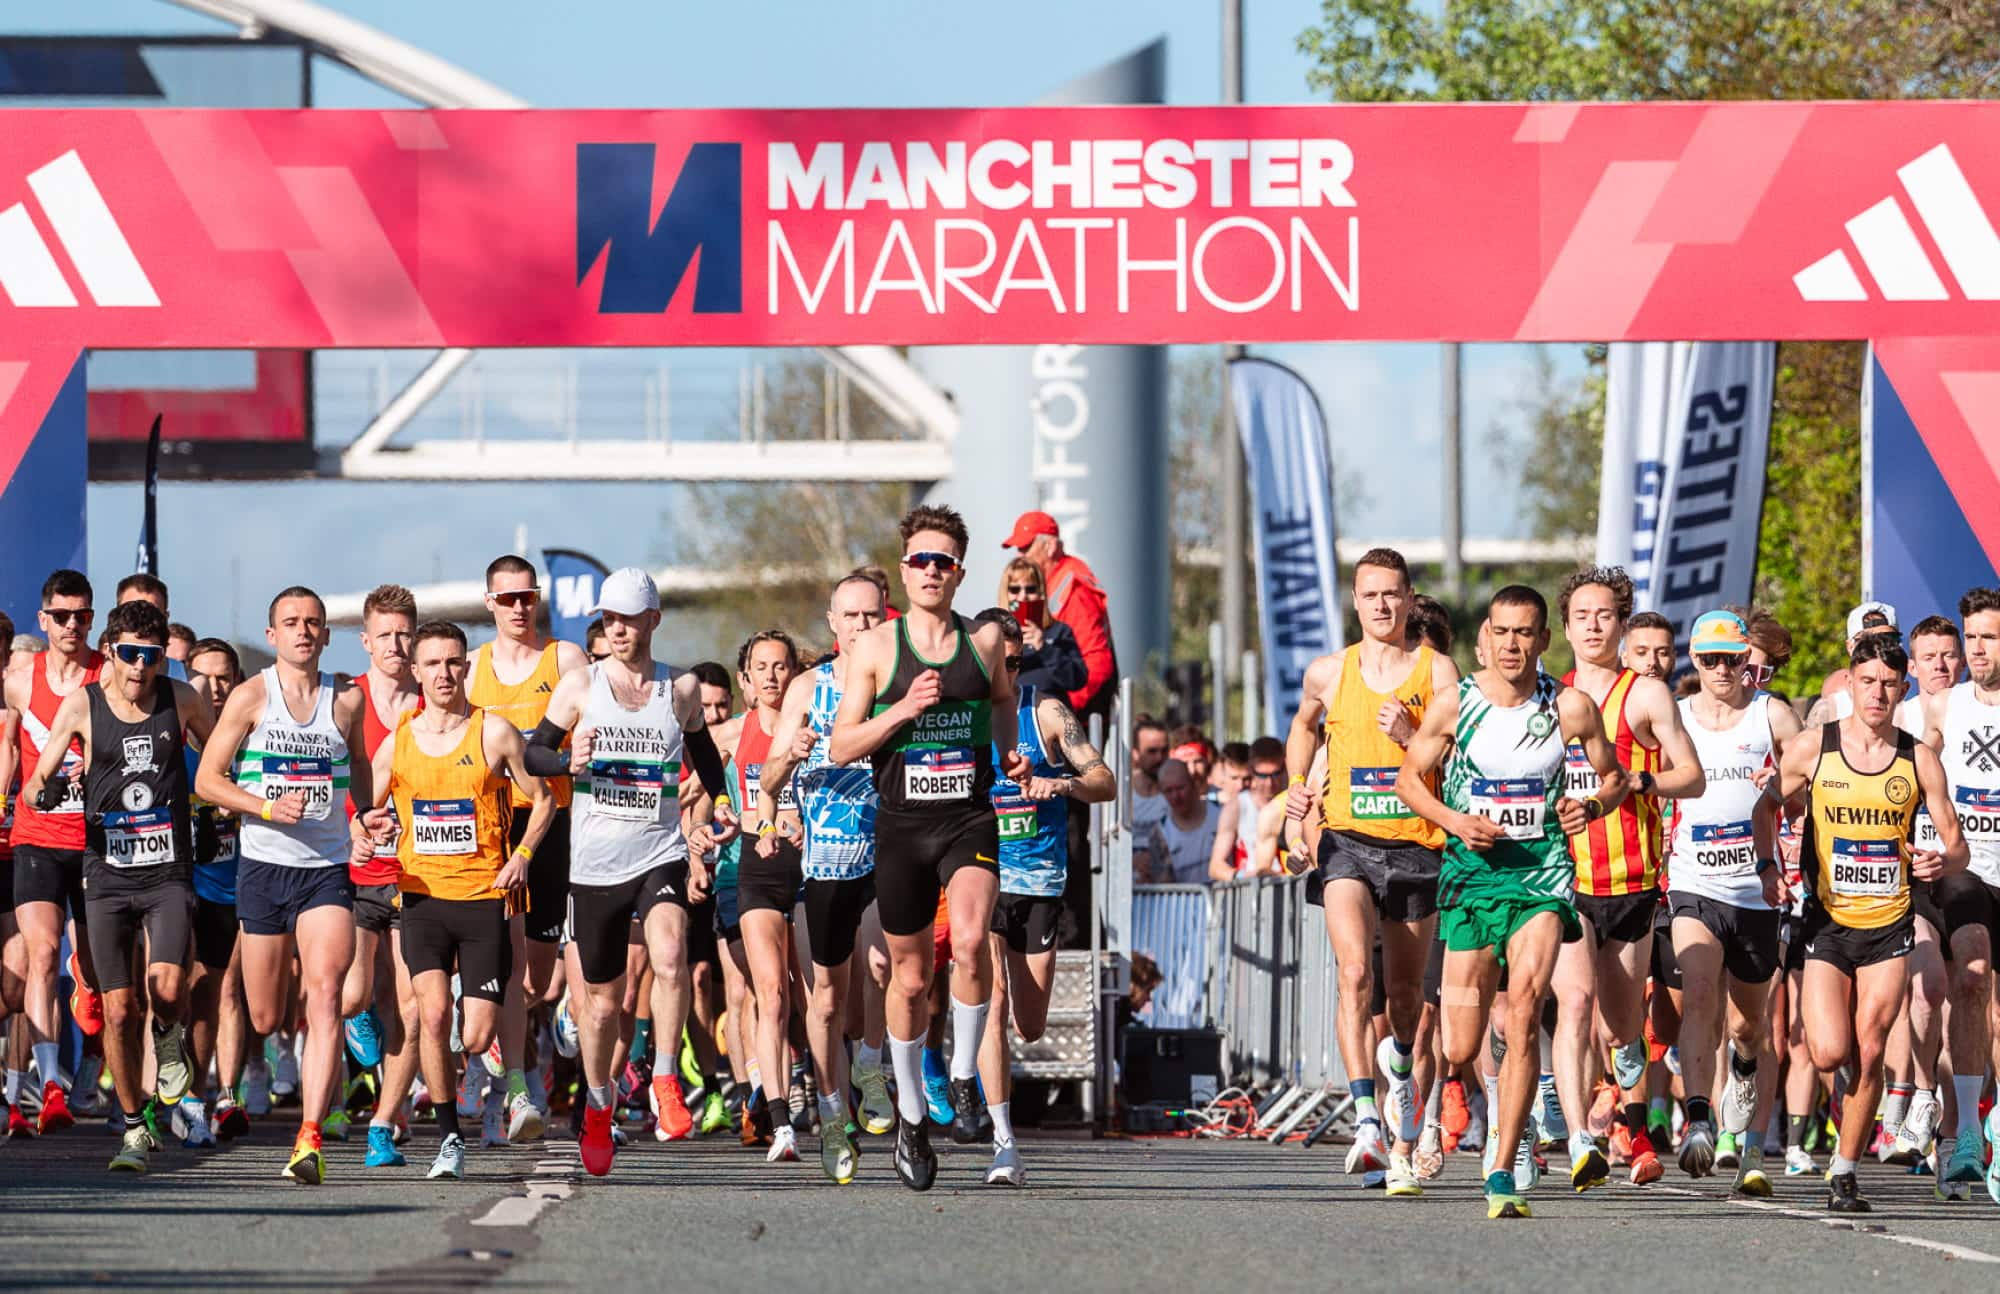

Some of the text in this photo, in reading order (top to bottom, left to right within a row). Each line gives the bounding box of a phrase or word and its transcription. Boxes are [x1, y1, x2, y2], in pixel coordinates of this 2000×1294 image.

[768, 138, 1356, 210] MANCHESTER
[768, 216, 1360, 314] MARATHON
[914, 711, 972, 728] VEGAN
[268, 729, 330, 746] SWANSEA
[594, 726, 664, 741] SWANSEA
[912, 727, 971, 742] RUNNERS
[910, 774, 974, 794] ROBERTS
[594, 788, 657, 809] KALLENBERG
[1824, 805, 1905, 826] NEWHAM
[415, 825, 473, 843] HAYMES
[108, 834, 170, 857] HUTTON
[1697, 846, 1755, 868] CORNEY
[1835, 863, 1898, 885] BRISLEY
